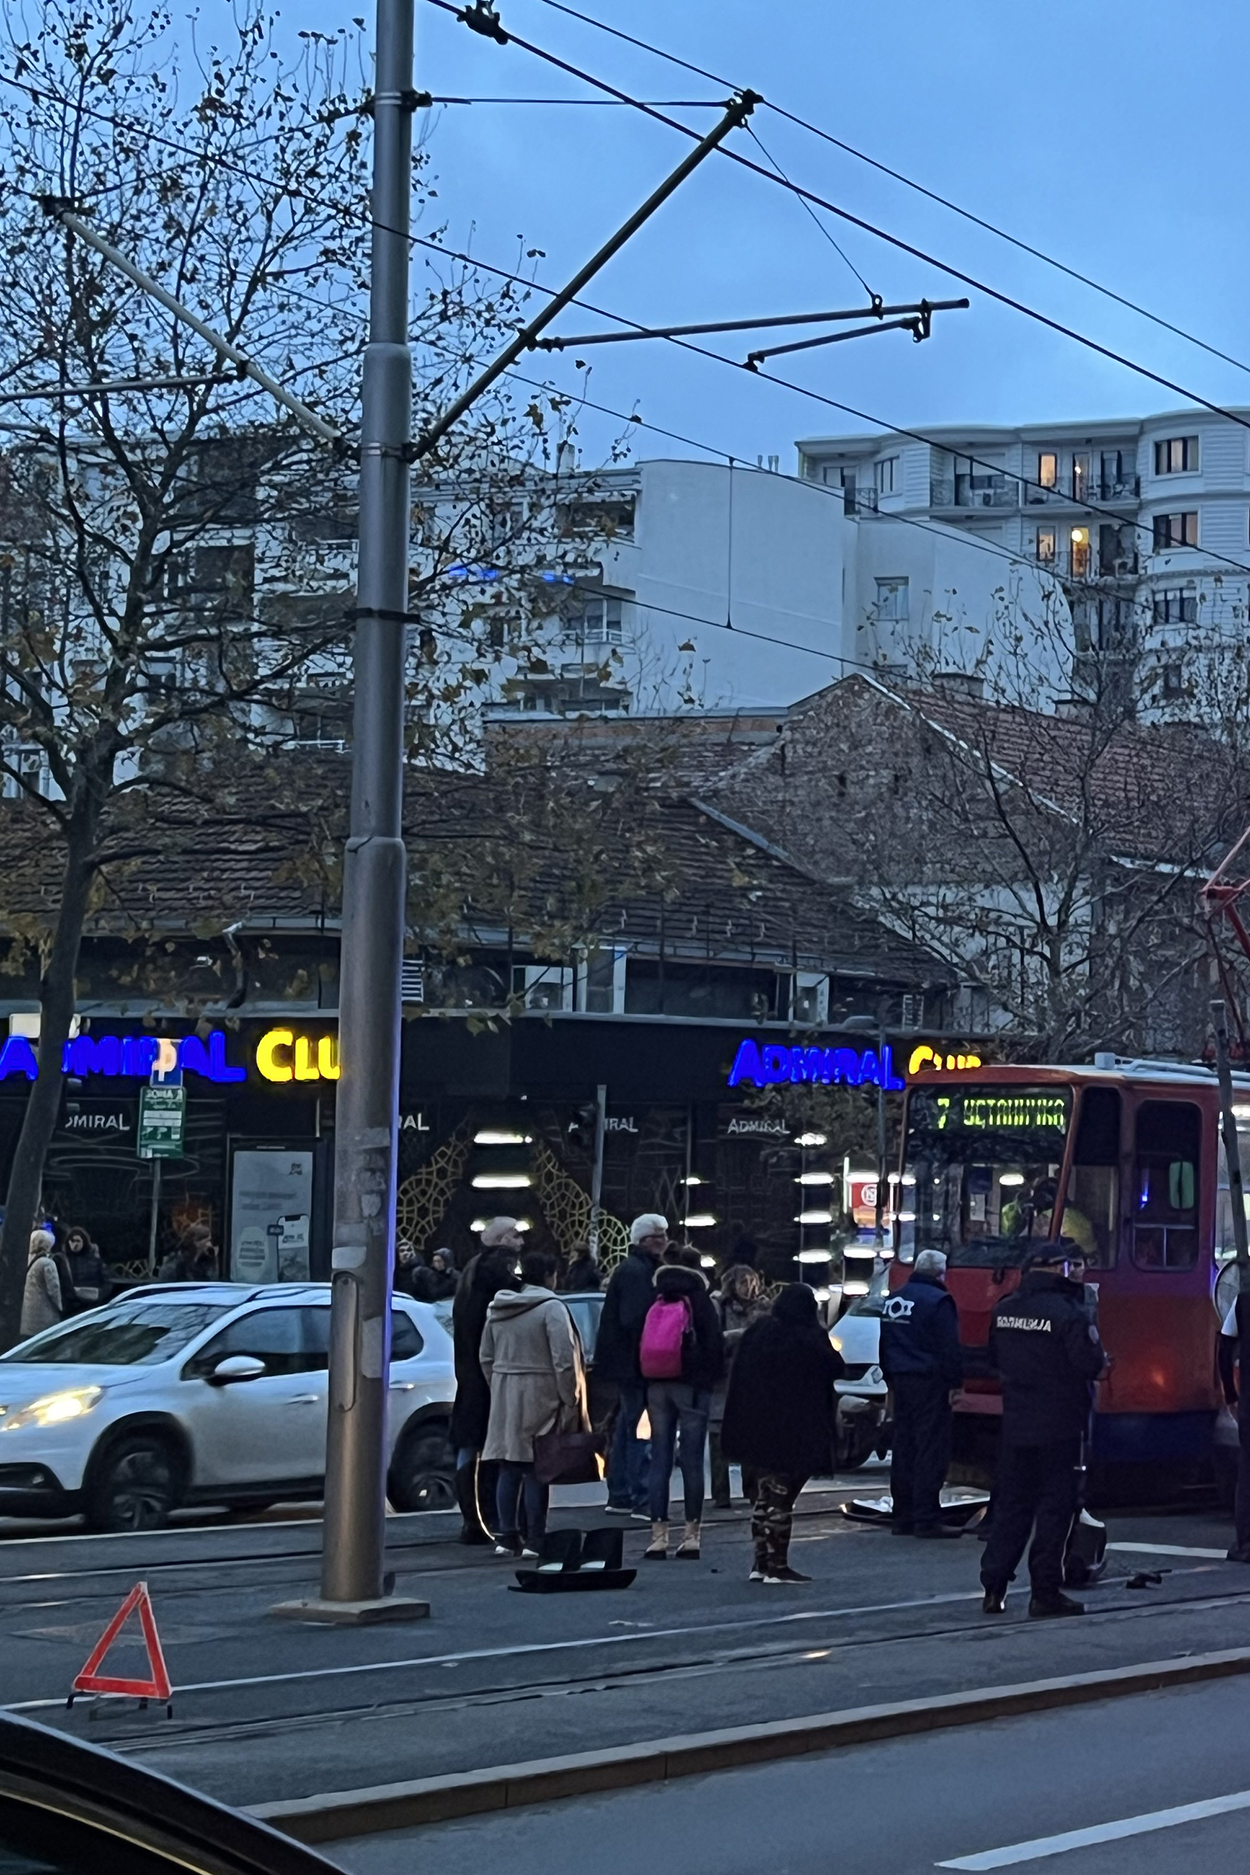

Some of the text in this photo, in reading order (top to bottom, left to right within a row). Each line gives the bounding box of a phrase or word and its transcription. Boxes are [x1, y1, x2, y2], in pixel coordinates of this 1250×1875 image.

[0, 1028, 341, 1082] AMIAL CLU
[728, 1039, 906, 1091] ADMIRAL
[65, 1113, 130, 1131] MIRAL
[937, 1098, 949, 1129] 7
